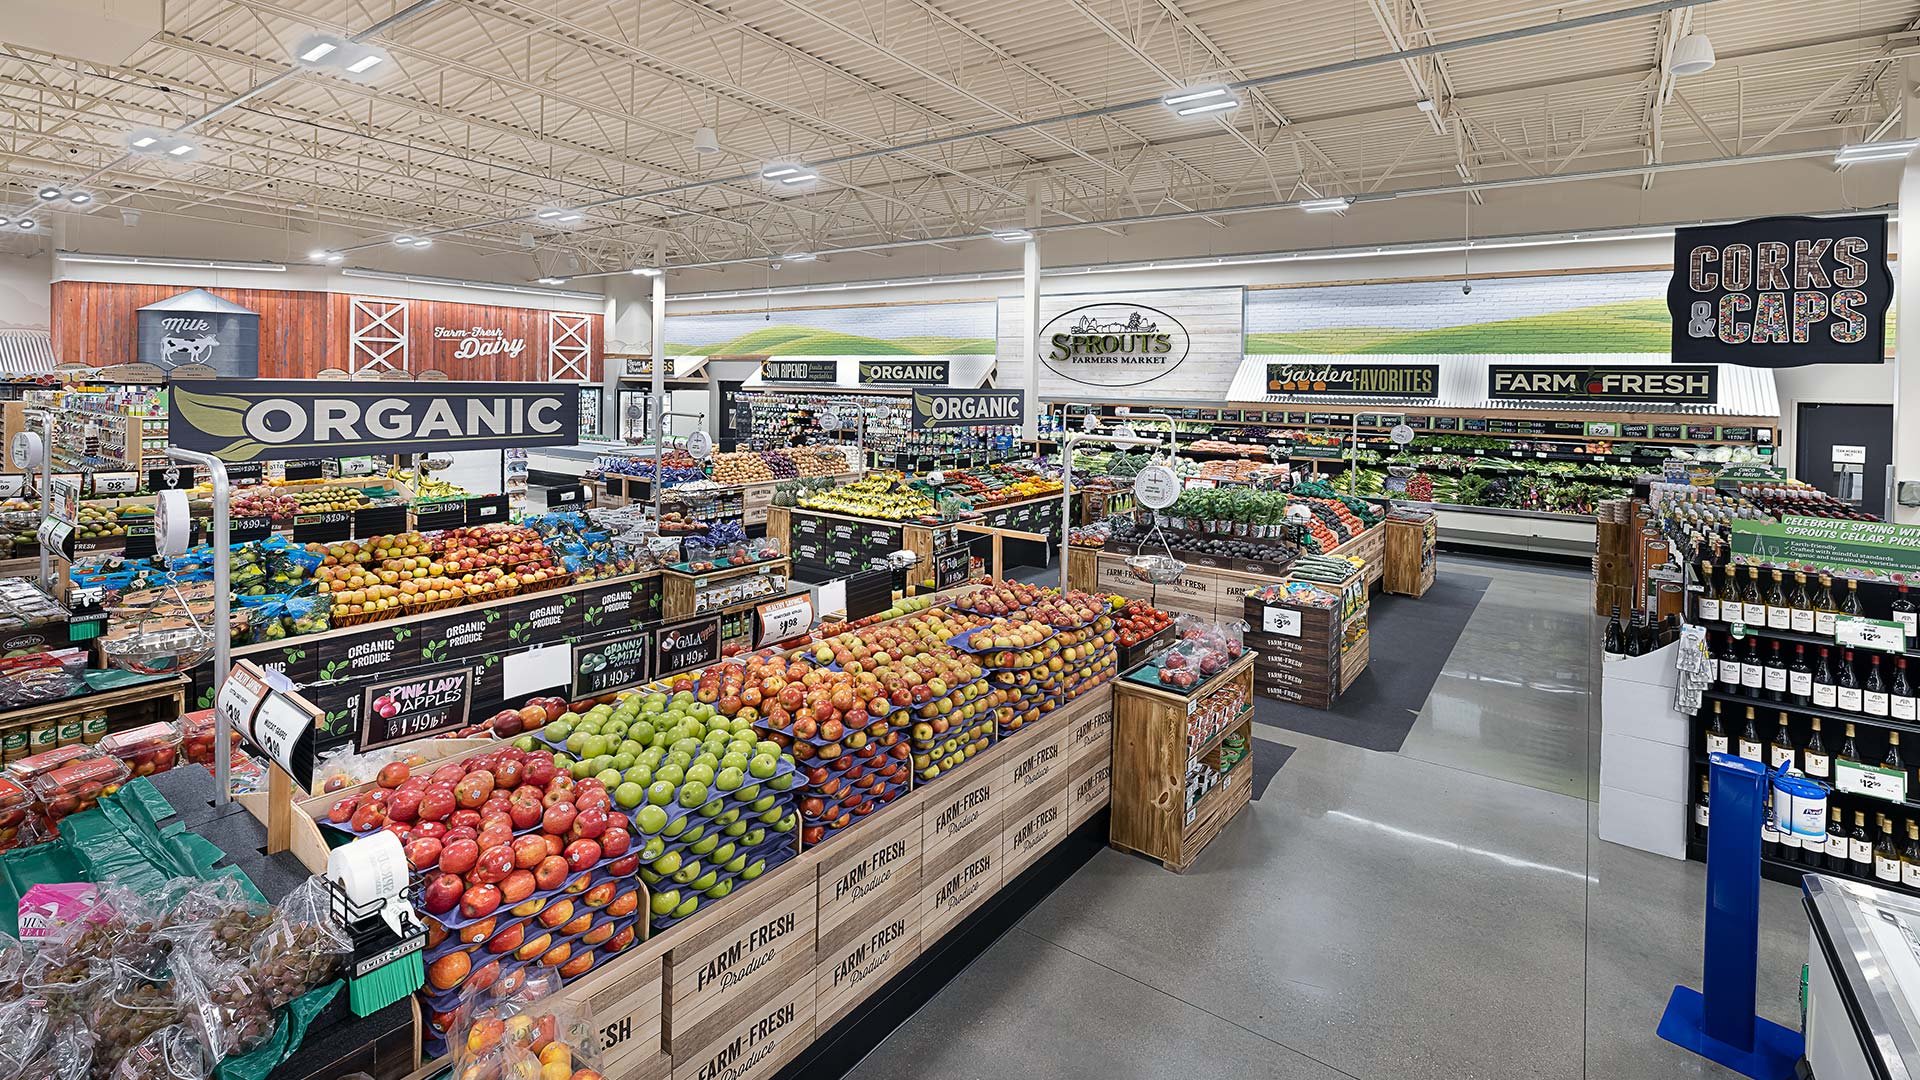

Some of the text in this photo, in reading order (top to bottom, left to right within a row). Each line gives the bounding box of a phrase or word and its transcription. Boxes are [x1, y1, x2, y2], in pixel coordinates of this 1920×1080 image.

[1689, 236, 1868, 293] CORKS
[162, 318, 210, 333] Milk
[1689, 289, 1868, 344] & CAPS
[434, 326, 503, 338] Farm-Fresh
[454, 336, 526, 359] Dairy
[1049, 333, 1171, 361] SPROUTS
[1072, 356, 1167, 364] FARMERS MARKET
[767, 363, 780, 379] SUN
[781, 363, 807, 379] RIPENED
[870, 365, 944, 379] ORGANIC
[1280, 364, 1432, 392] Garden FAVORITES
[1495, 374, 1709, 394] FARM FRESH
[931, 397, 1020, 419] ORGANIC
[245, 397, 563, 444] ORGANIC
[1784, 517, 1849, 530] CELEBRATE
[1851, 523, 1896, 535] SPRING
[1785, 527, 1837, 539] SPROUTS
[1840, 532, 1886, 544] CELLAR
[1830, 556, 1868, 564] sustainable
[602, 591, 632, 605] ORGANIC
[604, 601, 630, 613] PRODUCE
[529, 605, 564, 621] ORGANIC
[532, 616, 561, 629] PRODUCE
[446, 621, 486, 638] ORGANIC
[348, 640, 395, 659] ORGANIC
[449, 633, 483, 647] PRODUCE
[604, 638, 643, 656] GRANNY
[676, 634, 702, 650] GALA
[1268, 640, 1302, 651] FARM-FRESH
[352, 652, 391, 668] PRODUCE
[614, 658, 640, 668] APPLES
[1268, 656, 1302, 667] FARM-FRESH
[1268, 672, 1302, 684] FARM-FRESH
[389, 676, 465, 703] PINK LADY
[1267, 687, 1302, 700] FARM-FRESH
[402, 688, 462, 713] APPLES
[1014, 744, 1058, 784] FARM-FRESH
[1024, 766, 1049, 787] Produce
[936, 786, 990, 834] FARM-FRESH
[948, 809, 979, 837] Produce
[1014, 806, 1058, 851] FARM-FRESH
[1023, 828, 1049, 853] Produce
[836, 840, 905, 901] FARM-FRESH
[851, 869, 891, 904] Produce
[935, 855, 991, 909] FARM-FRESH
[948, 881, 979, 911] Produce
[698, 913, 795, 993] FARM-FRESH
[834, 919, 905, 988] FARM-FRESH
[720, 948, 776, 993] Produce
[850, 950, 891, 988] Produce
[699, 1003, 795, 1080] FARM-FRESH
